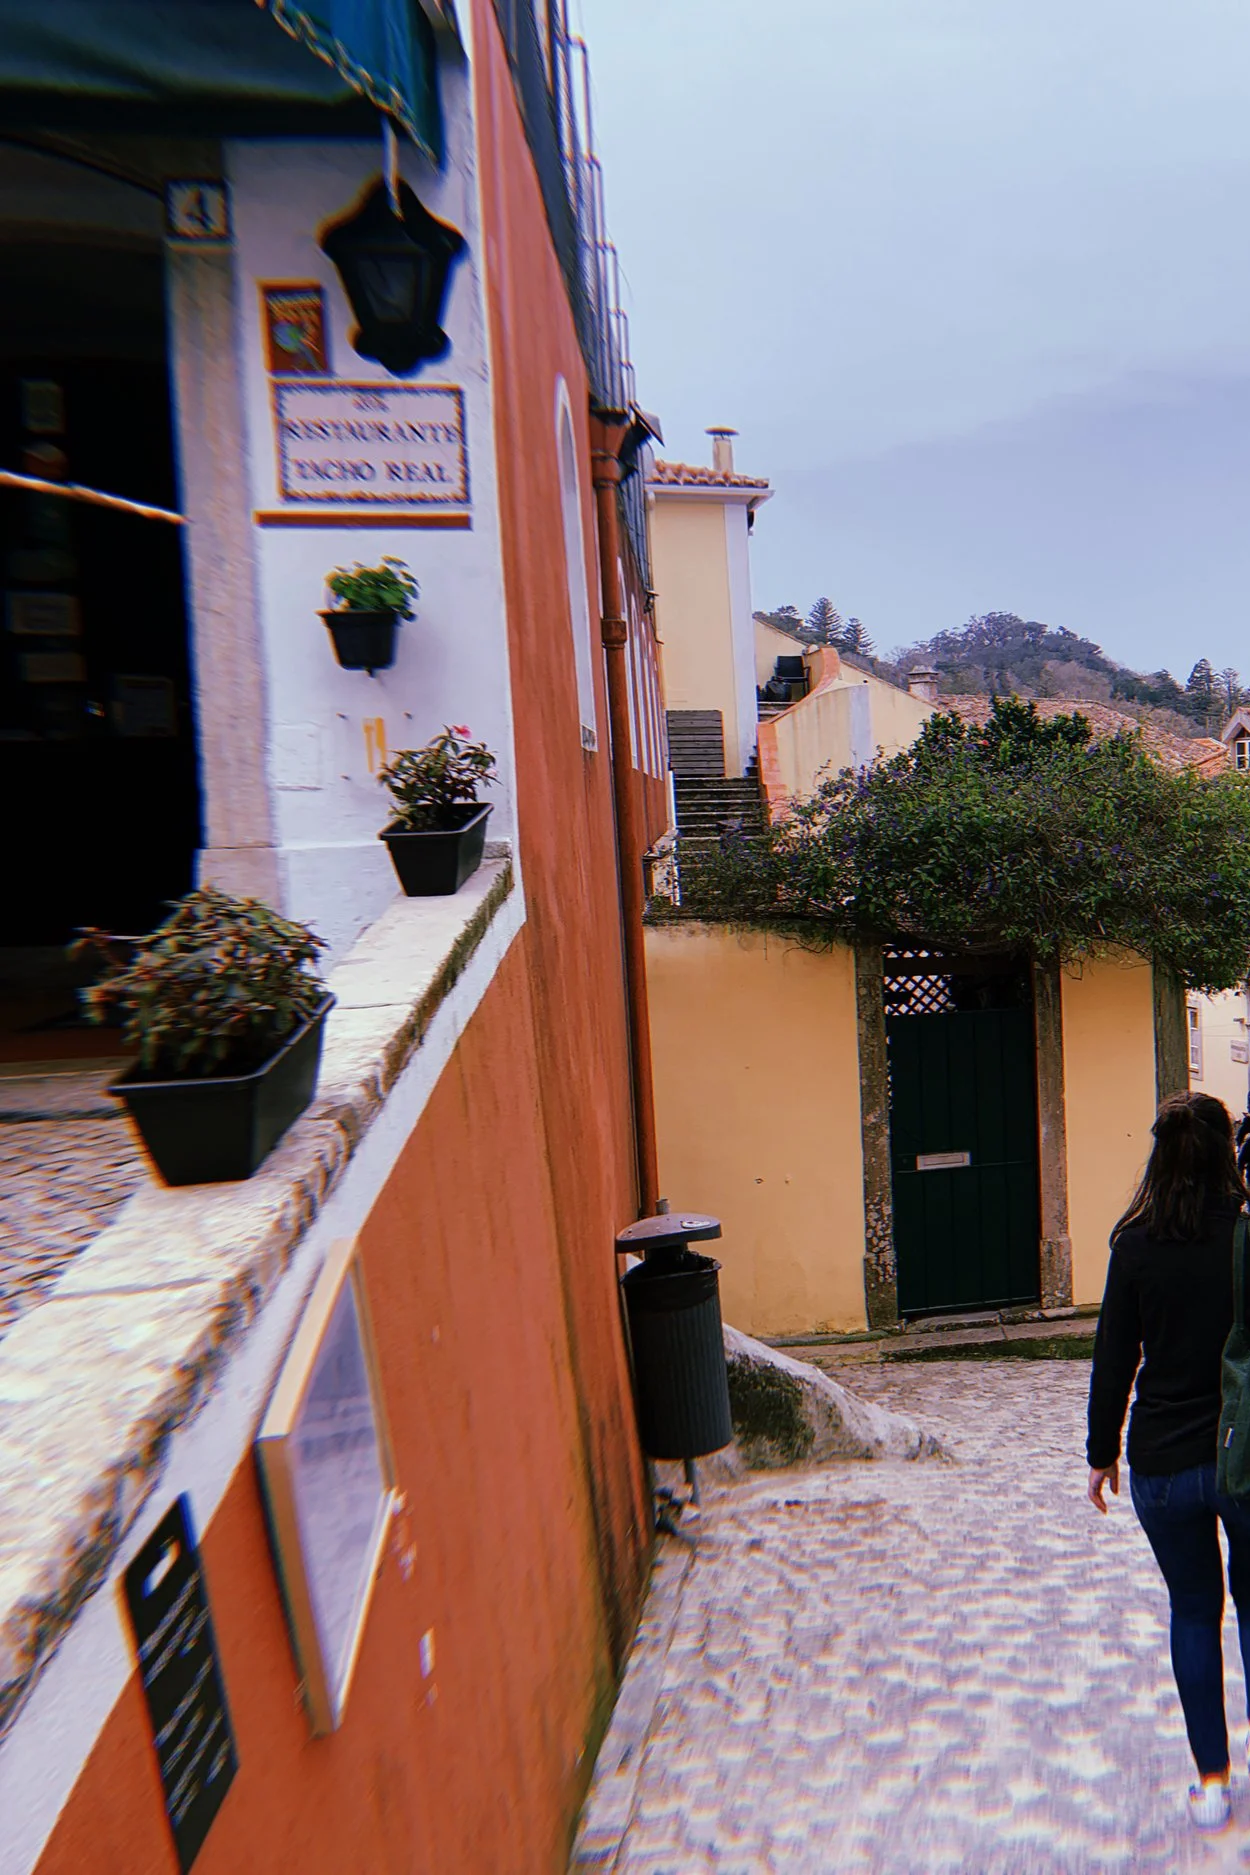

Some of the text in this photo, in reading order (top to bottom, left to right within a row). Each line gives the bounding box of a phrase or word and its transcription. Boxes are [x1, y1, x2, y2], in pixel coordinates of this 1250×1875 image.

[184, 189, 215, 232] 4
[285, 417, 463, 442] RESTAURANTE
[383, 460, 454, 483] REAL
